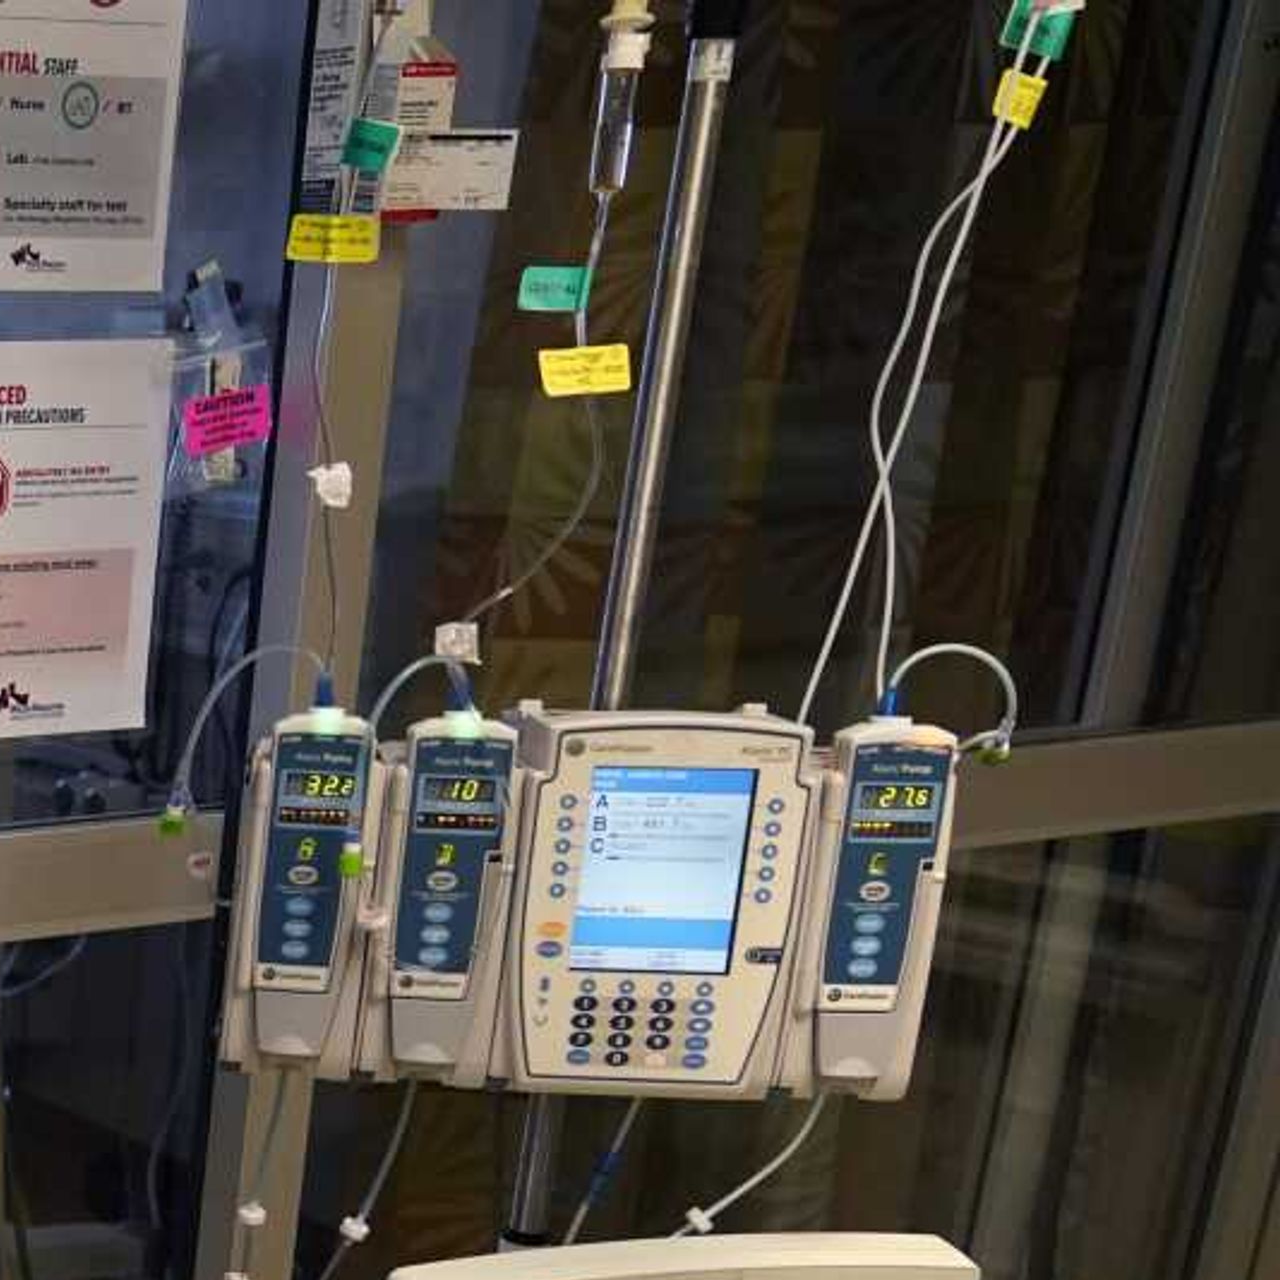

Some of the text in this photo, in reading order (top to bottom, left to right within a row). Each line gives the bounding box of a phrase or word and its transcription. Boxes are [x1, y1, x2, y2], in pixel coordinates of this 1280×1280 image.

[43, 57, 79, 76] STAFF
[5, 407, 86, 424] PRECAUTIONS
[595, 794, 609, 810] A
[593, 816, 607, 832] B
[590, 838, 604, 854] C
